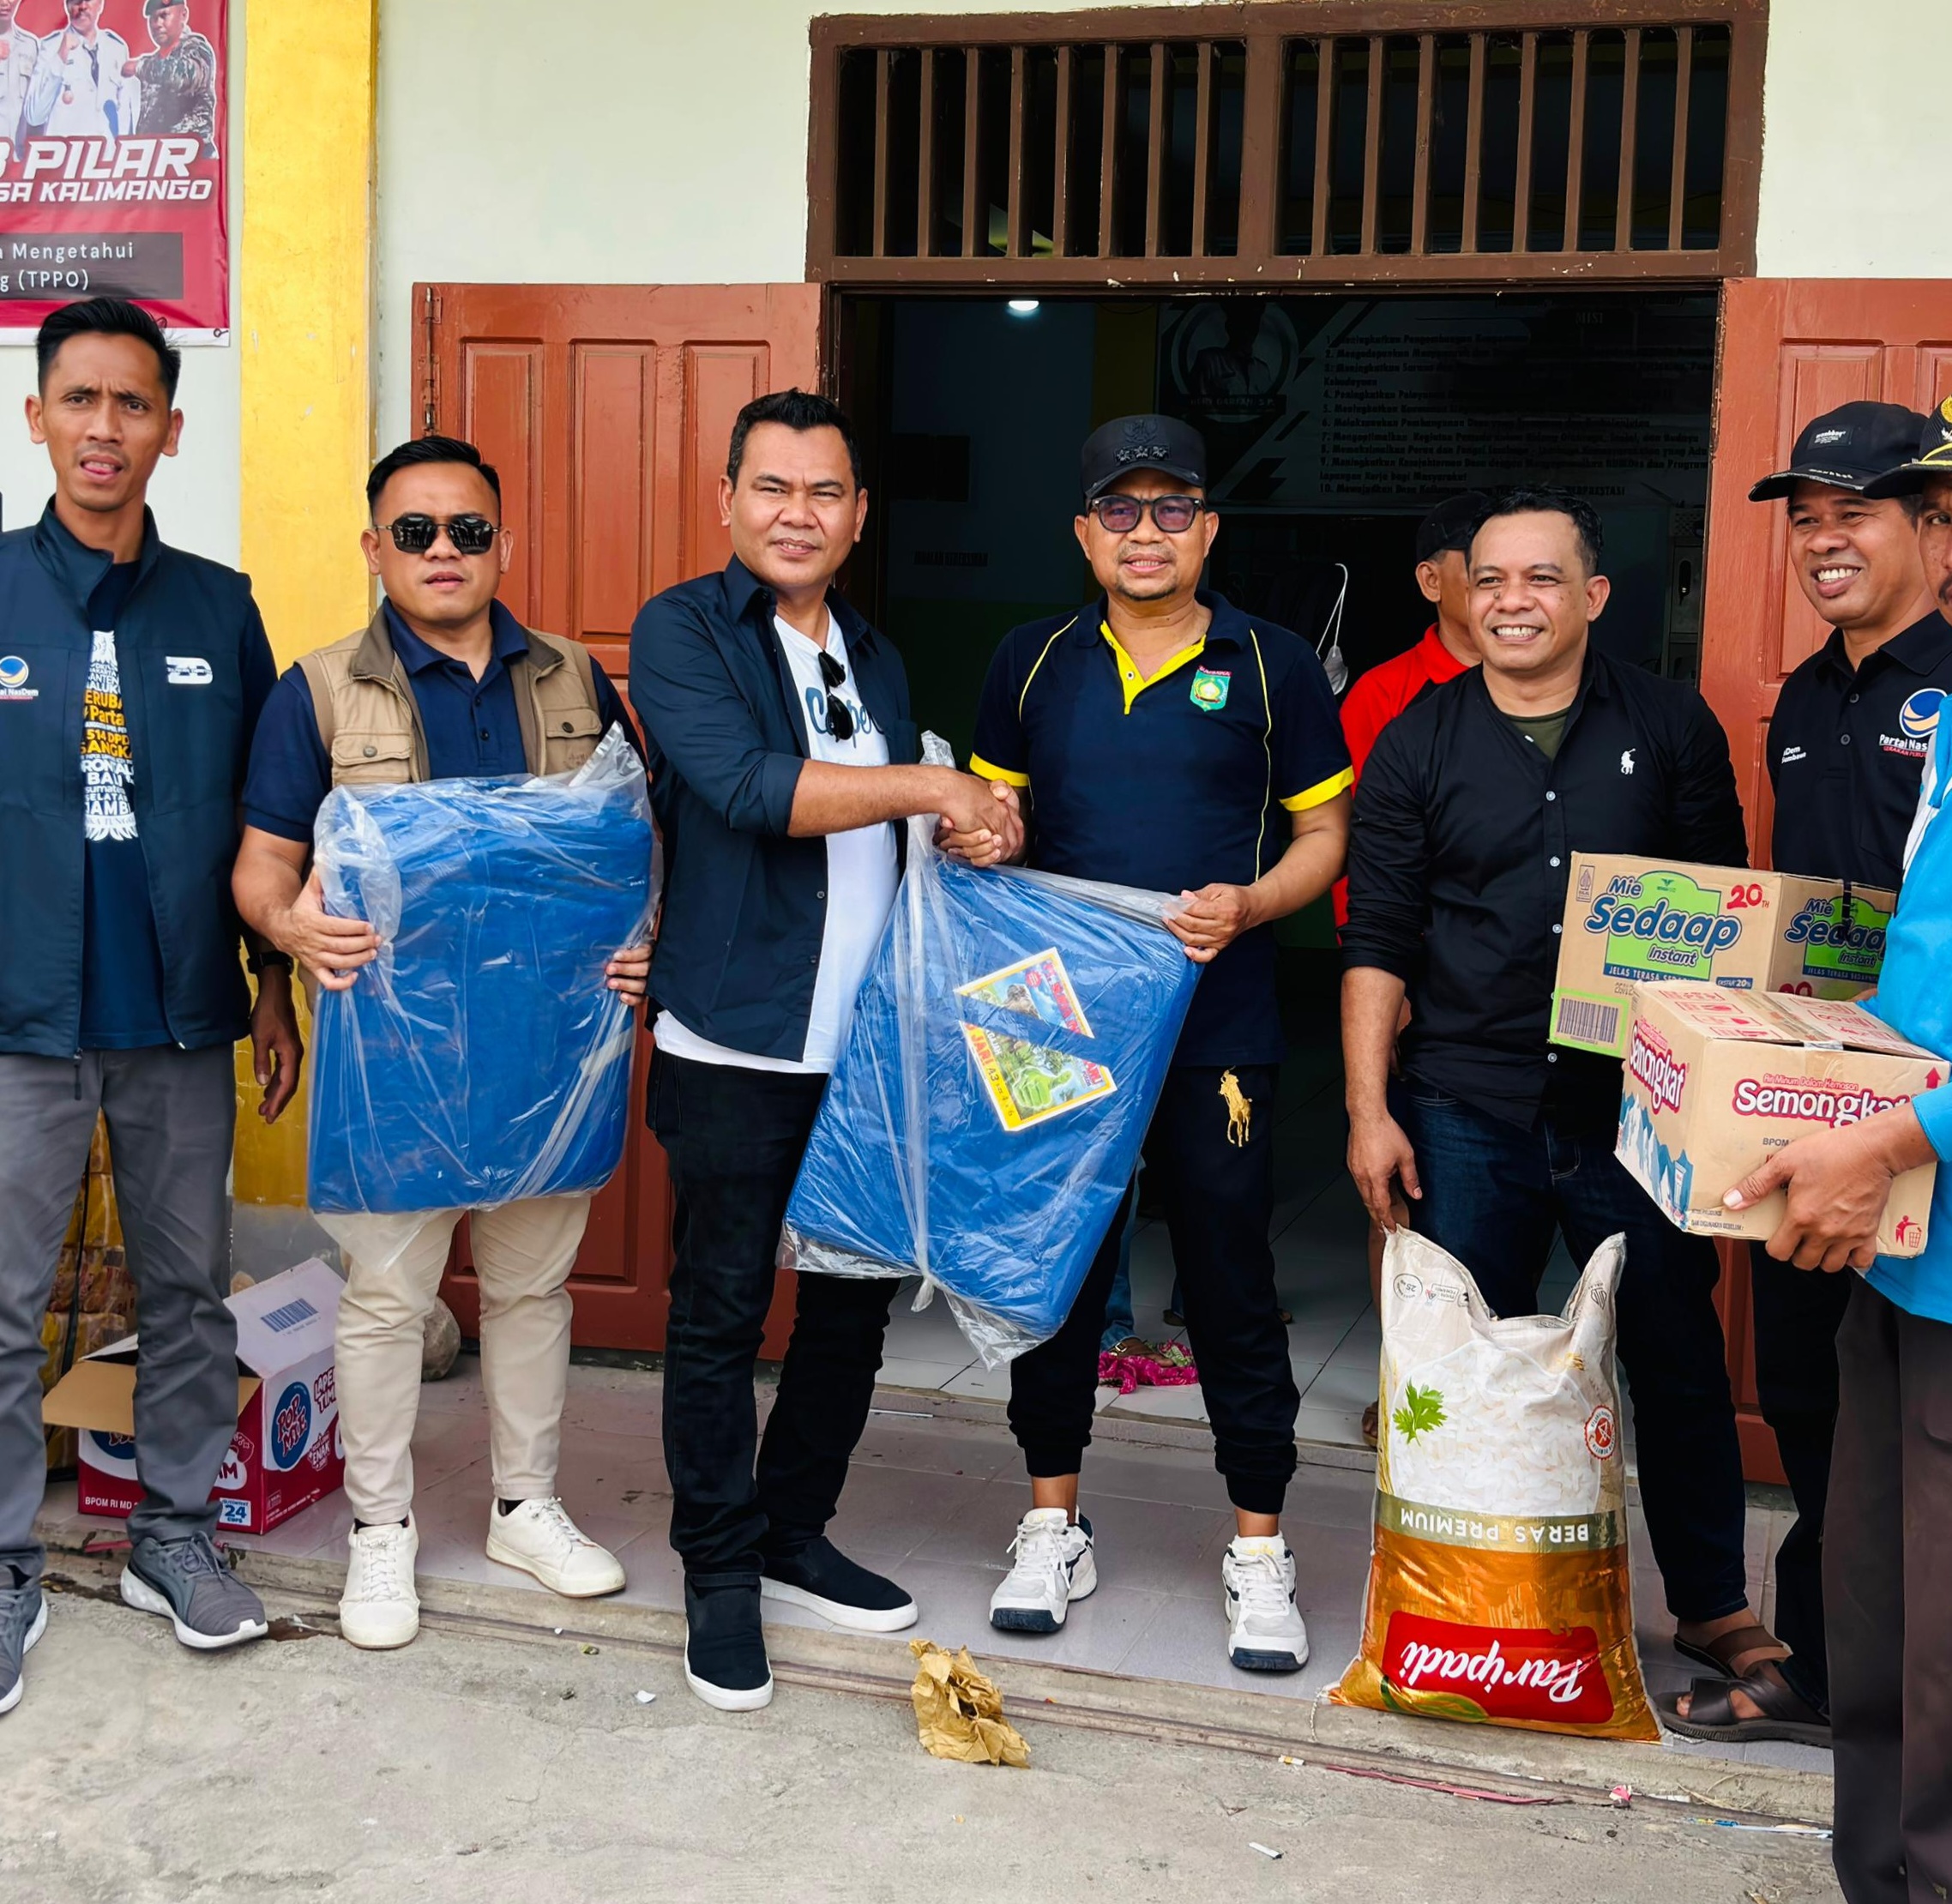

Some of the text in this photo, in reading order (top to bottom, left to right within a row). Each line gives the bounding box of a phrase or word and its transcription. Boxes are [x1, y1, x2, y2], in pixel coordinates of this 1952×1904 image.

[22, 138, 200, 178] PILAR
[39, 180, 212, 202] KALIMANGO
[13, 243, 133, 263] Mengetahui
[18, 269, 89, 291] (TPPO)
[88, 673, 119, 684] ANTEN
[1879, 734, 1908, 749] Partai
[1608, 877, 1642, 897] Mie
[1805, 900, 1834, 915] Mie
[1586, 897, 1741, 956] Sedaap
[1648, 946, 1698, 967] Instant
[1840, 951, 1877, 967] Instant
[1609, 966, 1630, 977] JELAS
[1633, 969, 1660, 981] TERASA
[1774, 1076, 1799, 1086] Minum
[1801, 1077, 1822, 1088] Dalam
[1825, 1078, 1859, 1091] Kemasan
[1762, 1137, 1790, 1148] BPOM
[85, 1496, 132, 1509] BPOM RI MD
[225, 1504, 247, 1519] 24
[1400, 1508, 1589, 1543] BERAS PREMIUM
[1399, 1640, 1583, 1703] Paripadi
